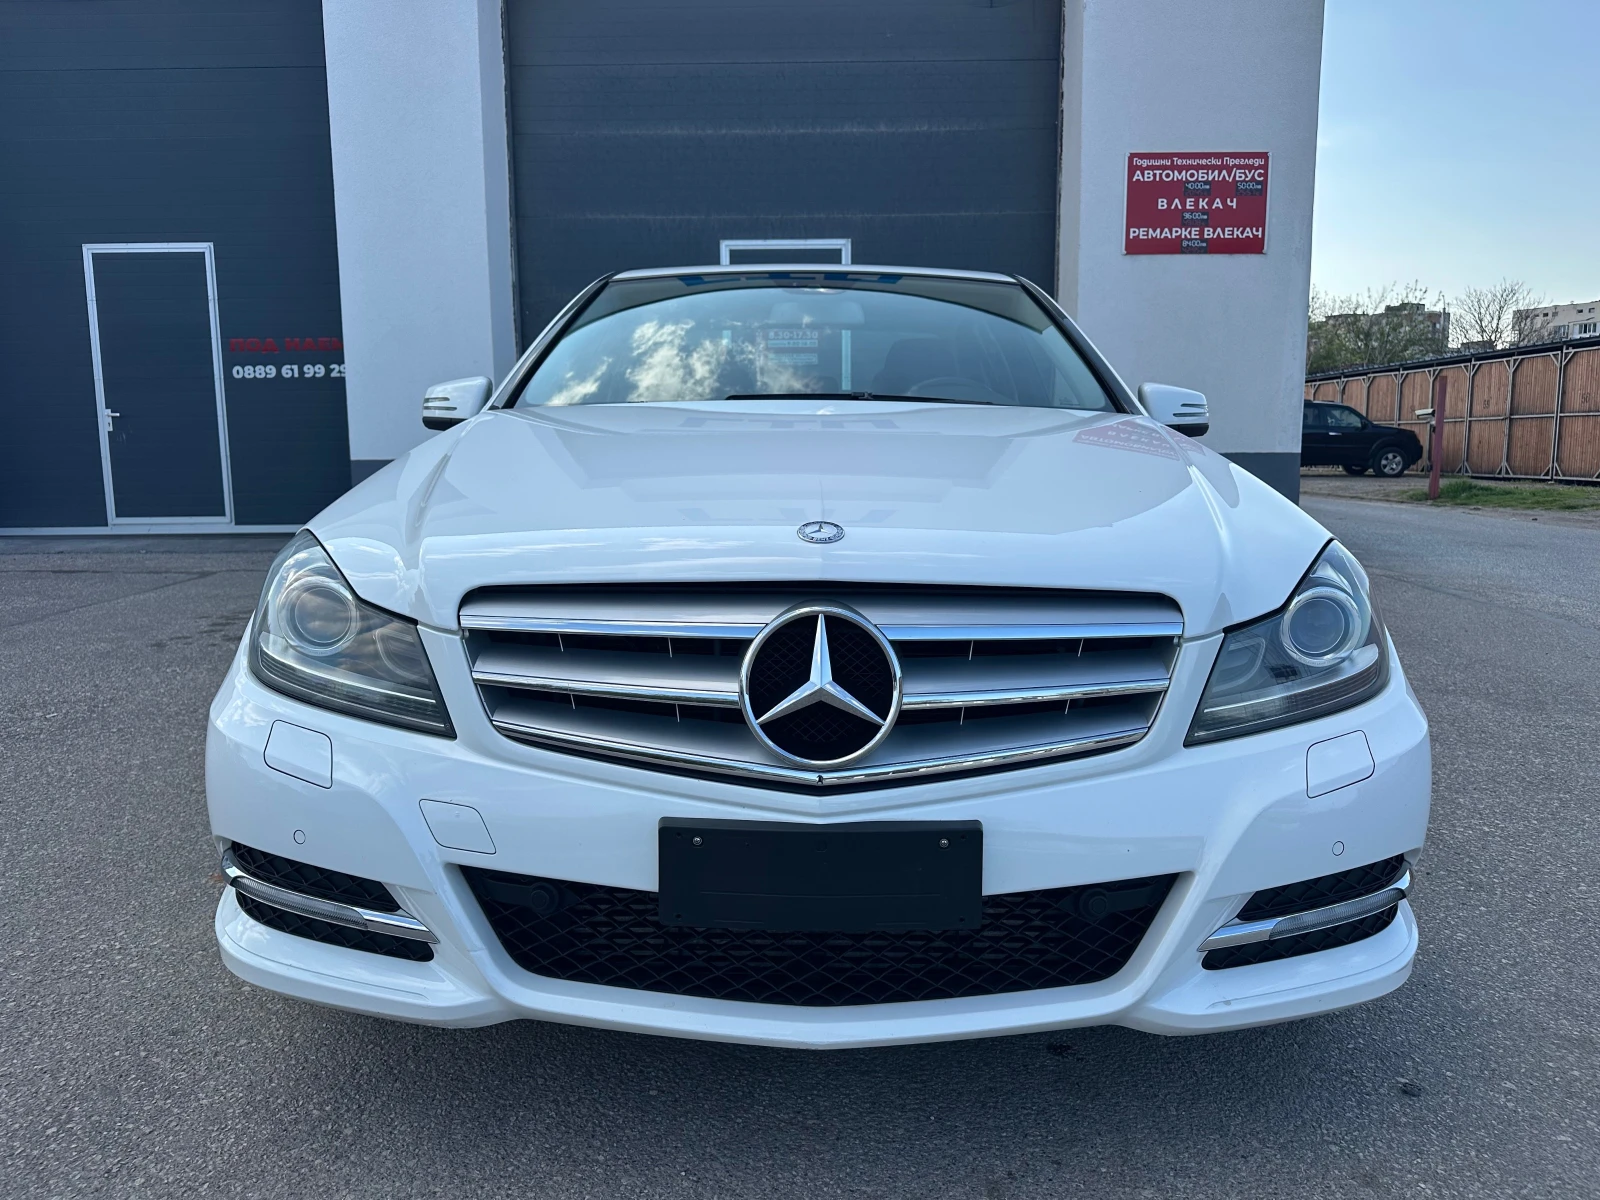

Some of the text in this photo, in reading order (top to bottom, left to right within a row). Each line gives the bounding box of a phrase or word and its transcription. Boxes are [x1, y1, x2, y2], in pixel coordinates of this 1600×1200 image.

[1133, 156, 1265, 168] Годишни Технически Прегледи
[1133, 168, 1264, 182] АВТОМОБИЛ/БУС
[1129, 227, 1263, 239] РЕМАРКЕ ВЛЕКАЧ
[229, 337, 280, 354] ПОД
[232, 365, 277, 379] 0889
[281, 364, 299, 378] 61
[303, 363, 326, 378] 99
